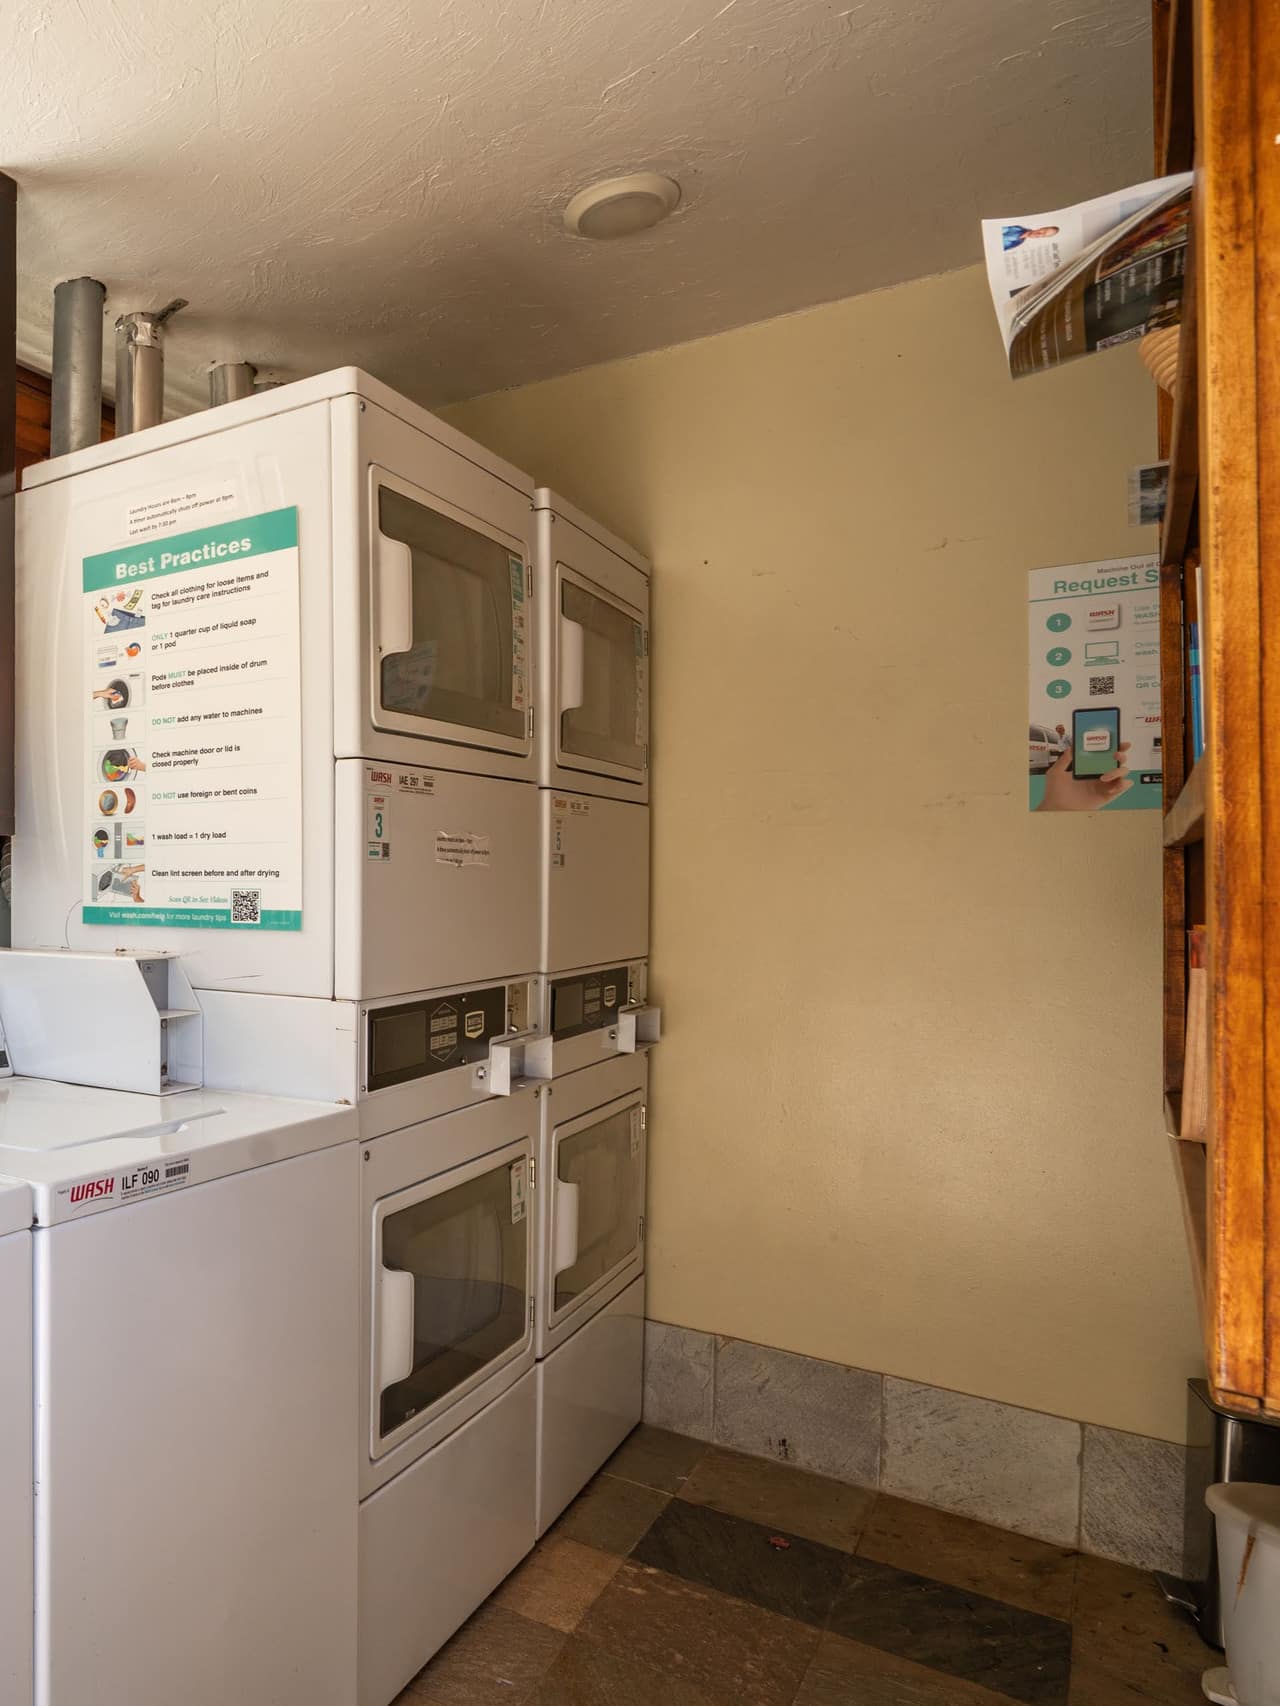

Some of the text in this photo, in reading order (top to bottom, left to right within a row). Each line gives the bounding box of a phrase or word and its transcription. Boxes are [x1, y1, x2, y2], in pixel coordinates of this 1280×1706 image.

[146, 508, 177, 520] automatically
[115, 536, 252, 580] Best Practices
[151, 592, 170, 600] Check
[171, 589, 179, 597] all
[180, 583, 205, 595] clothing
[217, 578, 235, 587] loose
[236, 573, 255, 583] items
[256, 570, 269, 579] and
[1053, 571, 1138, 594] Request
[151, 602, 161, 610] tag
[171, 596, 195, 606] laundry
[196, 592, 211, 601] care
[211, 584, 251, 597] instructions
[151, 632, 168, 641] ONLY
[174, 628, 197, 639] quarter
[198, 626, 211, 634] cup
[211, 623, 219, 631] of
[219, 620, 239, 630] liquid
[239, 617, 257, 627] soap
[164, 640, 177, 650] pod
[168, 670, 186, 679] MUST
[197, 666, 218, 676] placed
[219, 663, 240, 672] inside
[241, 661, 249, 669] of
[249, 659, 268, 668] drum
[151, 679, 195, 691] before clothes
[151, 717, 162, 726] DO
[162, 716, 176, 724] NOT
[176, 715, 189, 723] add
[190, 714, 202, 722] any
[202, 712, 221, 720] water
[230, 707, 263, 717] machines
[151, 750, 171, 759] Check
[171, 748, 198, 757] machine
[199, 746, 215, 754] door
[234, 744, 241, 752] is
[151, 757, 199, 768] closed properly
[370, 771, 392, 784] WASH
[152, 792, 162, 800] DO
[162, 791, 176, 800] NOT
[190, 790, 213, 798] foreign
[222, 788, 238, 796] bent
[238, 787, 258, 795] coins
[375, 812, 383, 838] 3
[173, 832, 188, 840] load
[199, 832, 211, 841] dry
[211, 831, 227, 839] load
[151, 869, 169, 877] Clean
[169, 869, 181, 877] lint
[203, 869, 225, 877] before
[225, 869, 239, 877] and
[239, 869, 256, 877] after
[257, 869, 280, 879] drying
[108, 911, 121, 919] Visit
[166, 912, 174, 920] for
[191, 912, 214, 922] laundry
[215, 913, 227, 922] tips
[70, 1177, 115, 1203] WASH
[121, 1174, 139, 1191] ILF
[141, 1168, 160, 1186] 090
